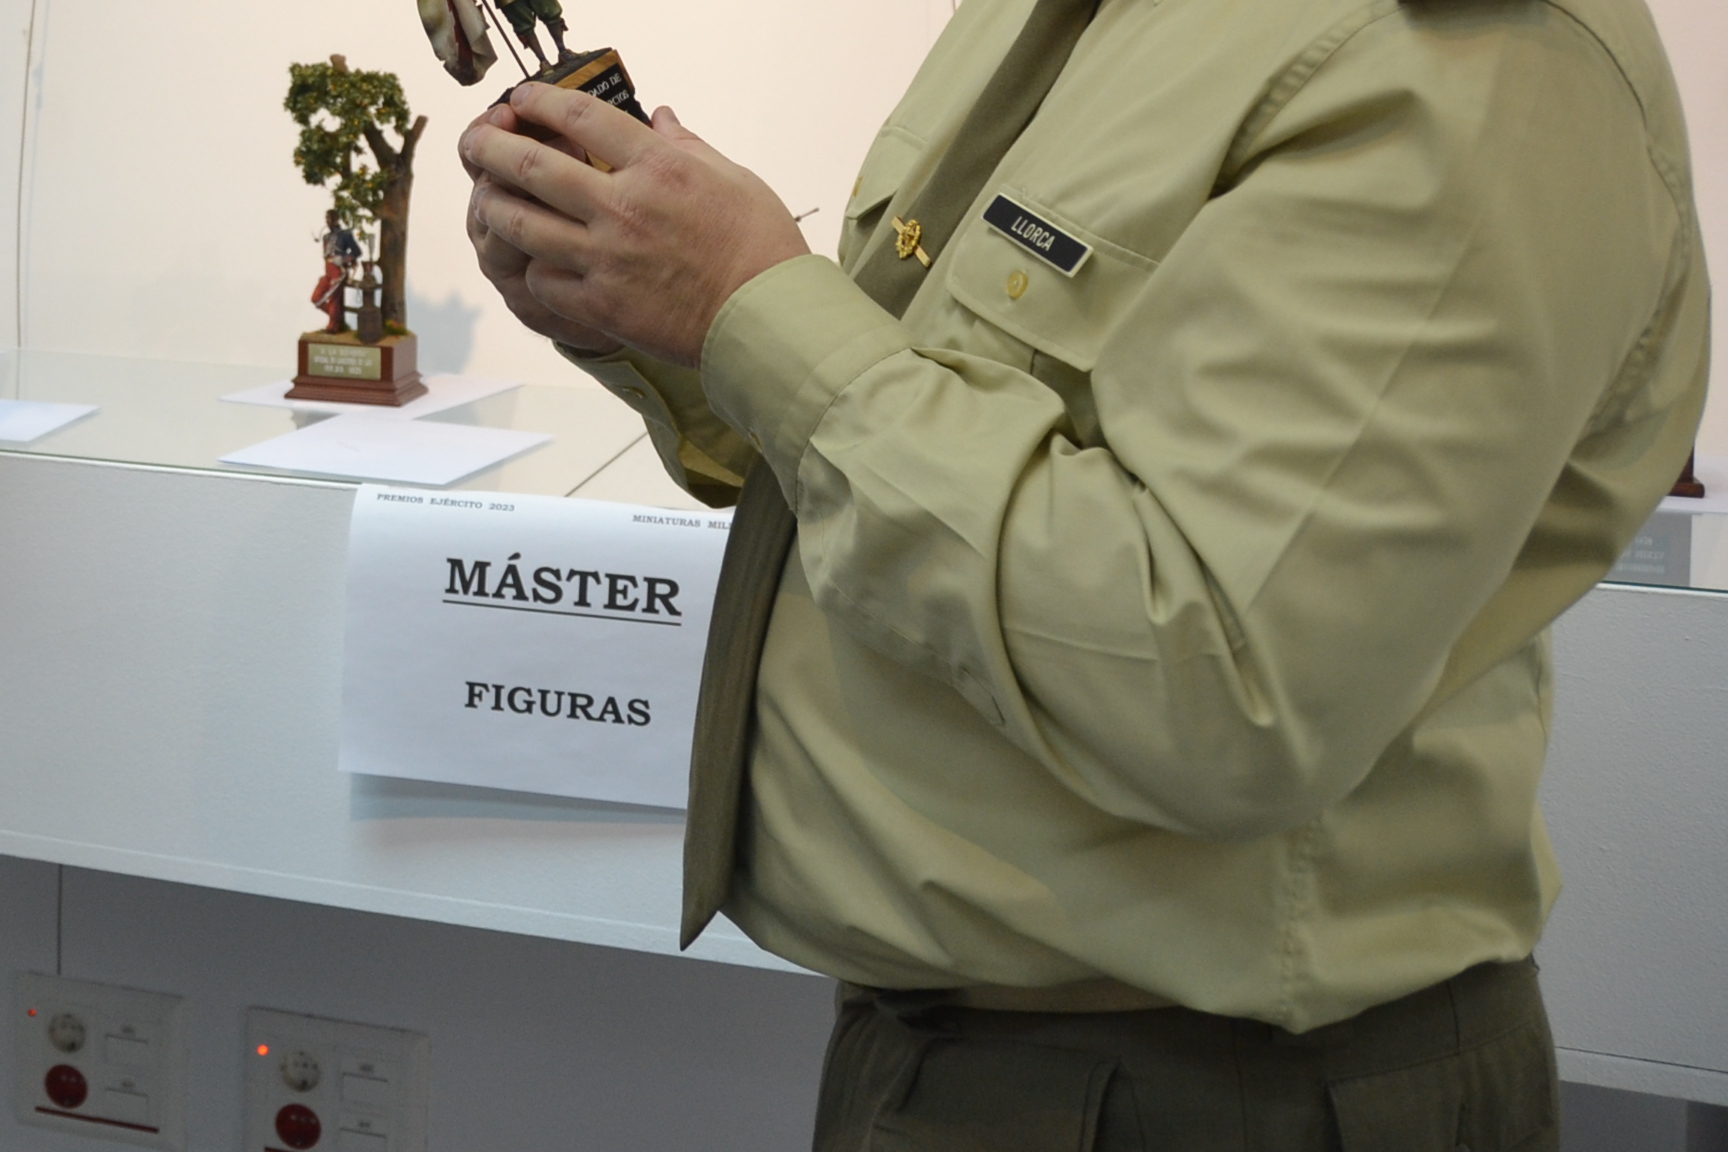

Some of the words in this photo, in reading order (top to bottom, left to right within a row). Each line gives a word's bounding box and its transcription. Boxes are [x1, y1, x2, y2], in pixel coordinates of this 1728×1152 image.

[609, 73, 622, 86] DE
[1011, 216, 1056, 252] LLORCA
[377, 493, 424, 504] PREMIOS
[430, 497, 483, 509] EJÉRCITO
[489, 503, 515, 512] 2023
[633, 515, 701, 528] MINIATURAS
[444, 552, 683, 617] MÁSTER
[464, 681, 652, 726] FIGURAS
